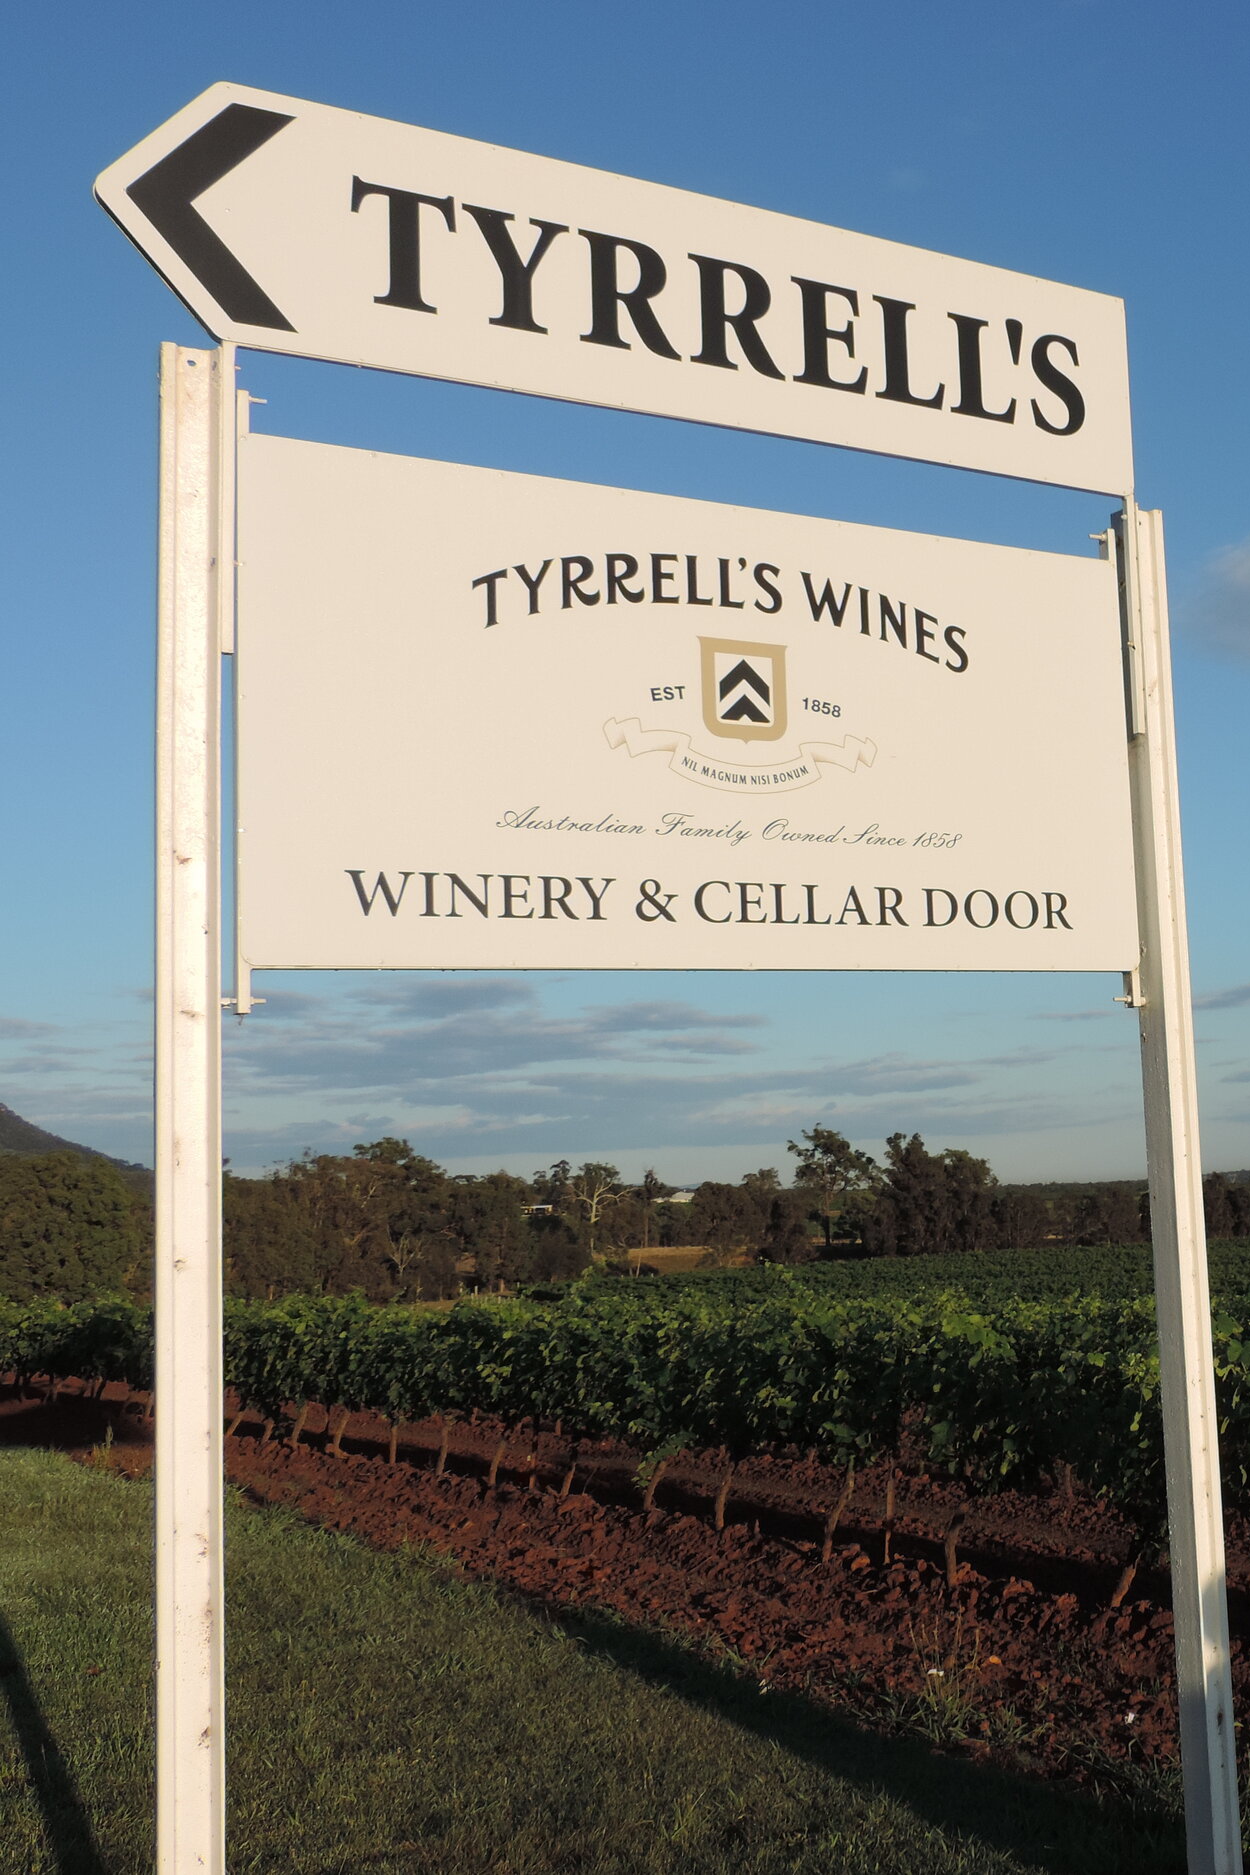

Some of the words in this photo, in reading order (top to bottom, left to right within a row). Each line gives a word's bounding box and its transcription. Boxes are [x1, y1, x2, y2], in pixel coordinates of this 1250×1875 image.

[351, 175, 1086, 437] TYRRELL'S
[471, 552, 784, 629] TYRRELL'S
[800, 570, 970, 674] WINES
[650, 685, 686, 702] EST
[802, 697, 841, 718] 1858
[681, 756, 698, 772] NIL
[700, 765, 747, 785] MAGNUM
[750, 775, 771, 785] NISI
[773, 765, 809, 784] BONUM
[495, 805, 647, 835] Australian
[655, 812, 752, 846] Family
[761, 818, 846, 844] Owned
[843, 823, 907, 846] Since
[912, 831, 963, 849] 1858
[344, 869, 617, 921] WINERY
[634, 878, 679, 923] &
[693, 880, 910, 928] CELLAR
[921, 888, 1074, 930] DOOR
